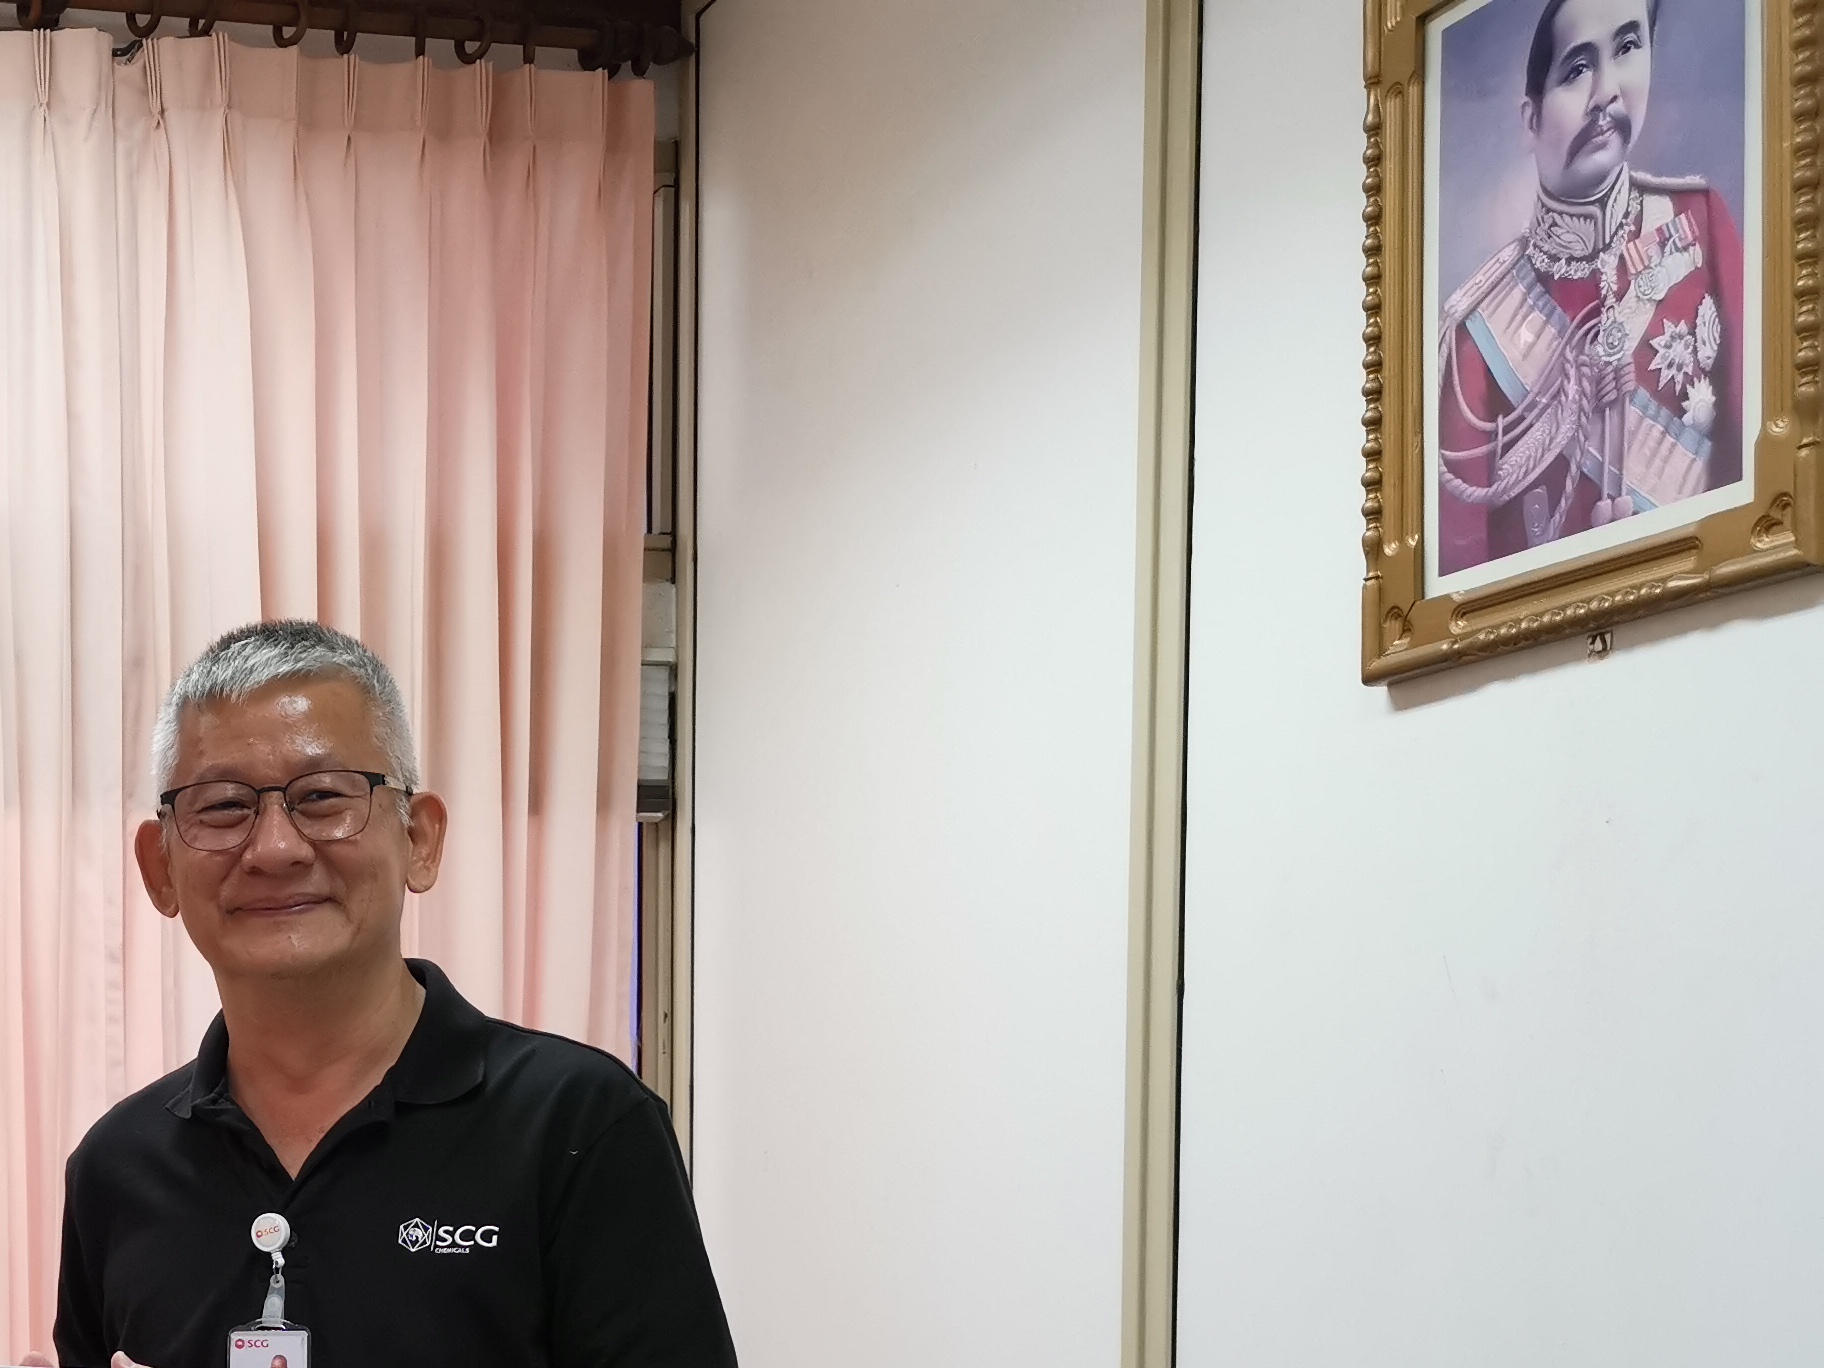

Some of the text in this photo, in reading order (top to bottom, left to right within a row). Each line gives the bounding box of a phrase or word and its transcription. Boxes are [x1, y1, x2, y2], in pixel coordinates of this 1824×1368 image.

[264, 1225, 280, 1236] SCG
[435, 1225, 500, 1248] SCG
[247, 1339, 269, 1348] SCG
